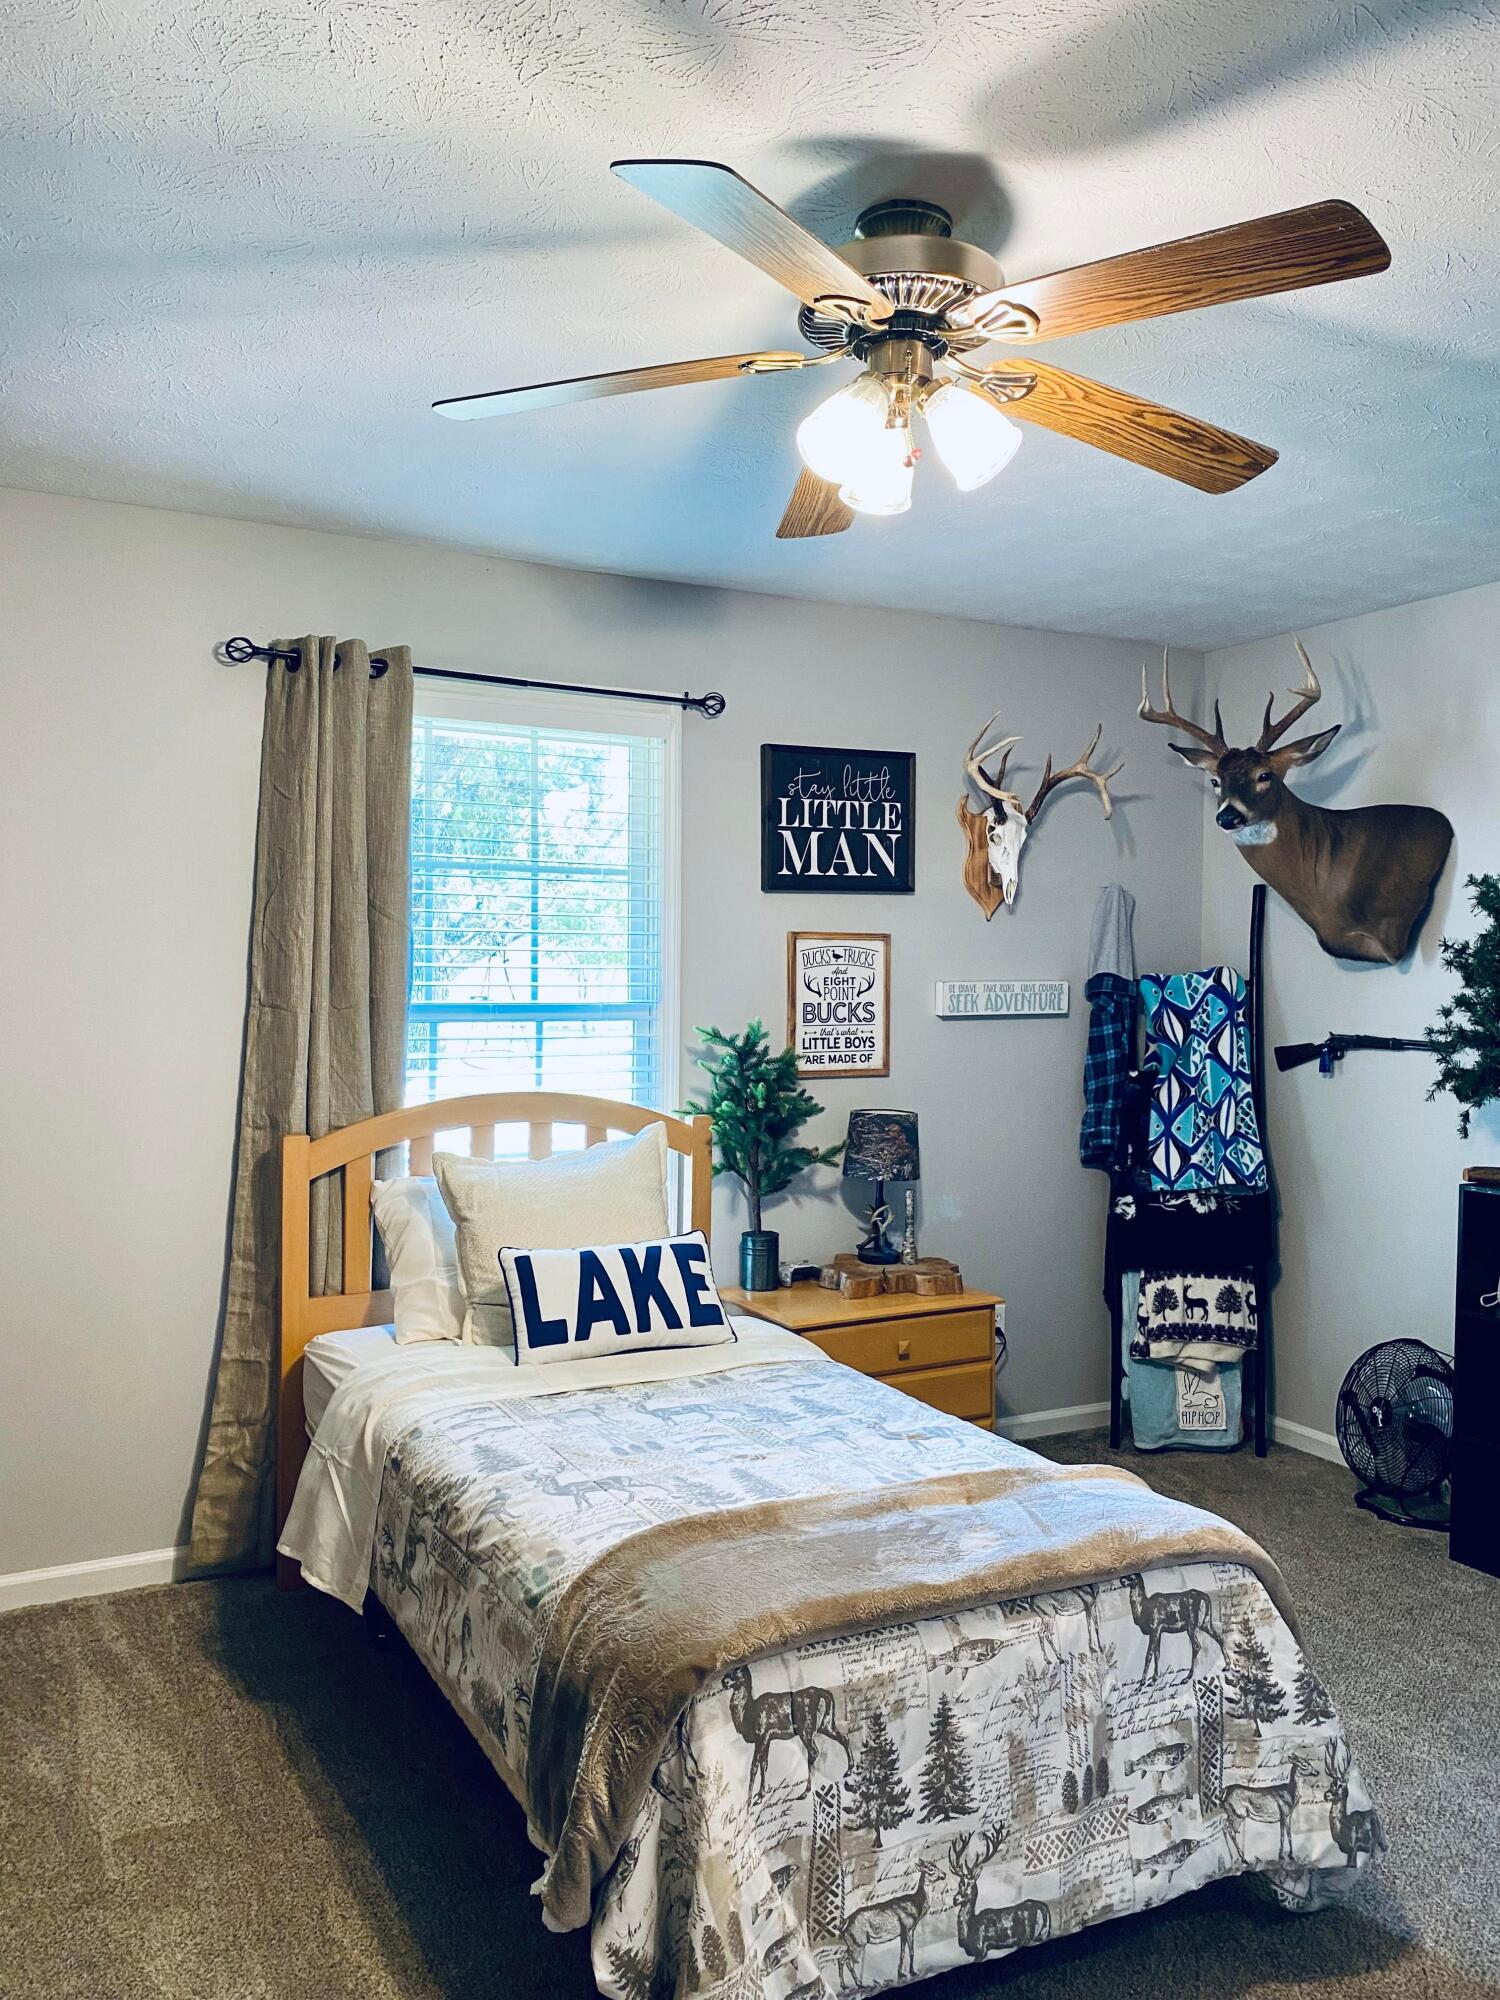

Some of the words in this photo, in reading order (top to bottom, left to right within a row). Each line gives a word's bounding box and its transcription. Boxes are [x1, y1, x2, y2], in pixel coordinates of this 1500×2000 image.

[788, 768, 836, 808] stay
[843, 764, 896, 802] little
[777, 797, 902, 831] LITTLE
[777, 830, 902, 877] MAN
[802, 948, 831, 967] DUCKS
[843, 948, 876, 967] TRUCKS
[823, 977, 856, 986] EIGHT
[823, 987, 856, 1001] POINT
[948, 993, 979, 1013] SEEK
[984, 991, 1064, 1012] ADVENTURE
[802, 1002, 876, 1023] BUCKS
[802, 1037, 841, 1050] LITTLE
[844, 1036, 875, 1049] BOYS
[805, 1054, 825, 1064] ARE
[828, 1054, 857, 1064] MADE
[859, 1053, 873, 1063] OF
[514, 1243, 724, 1349] LAKE
